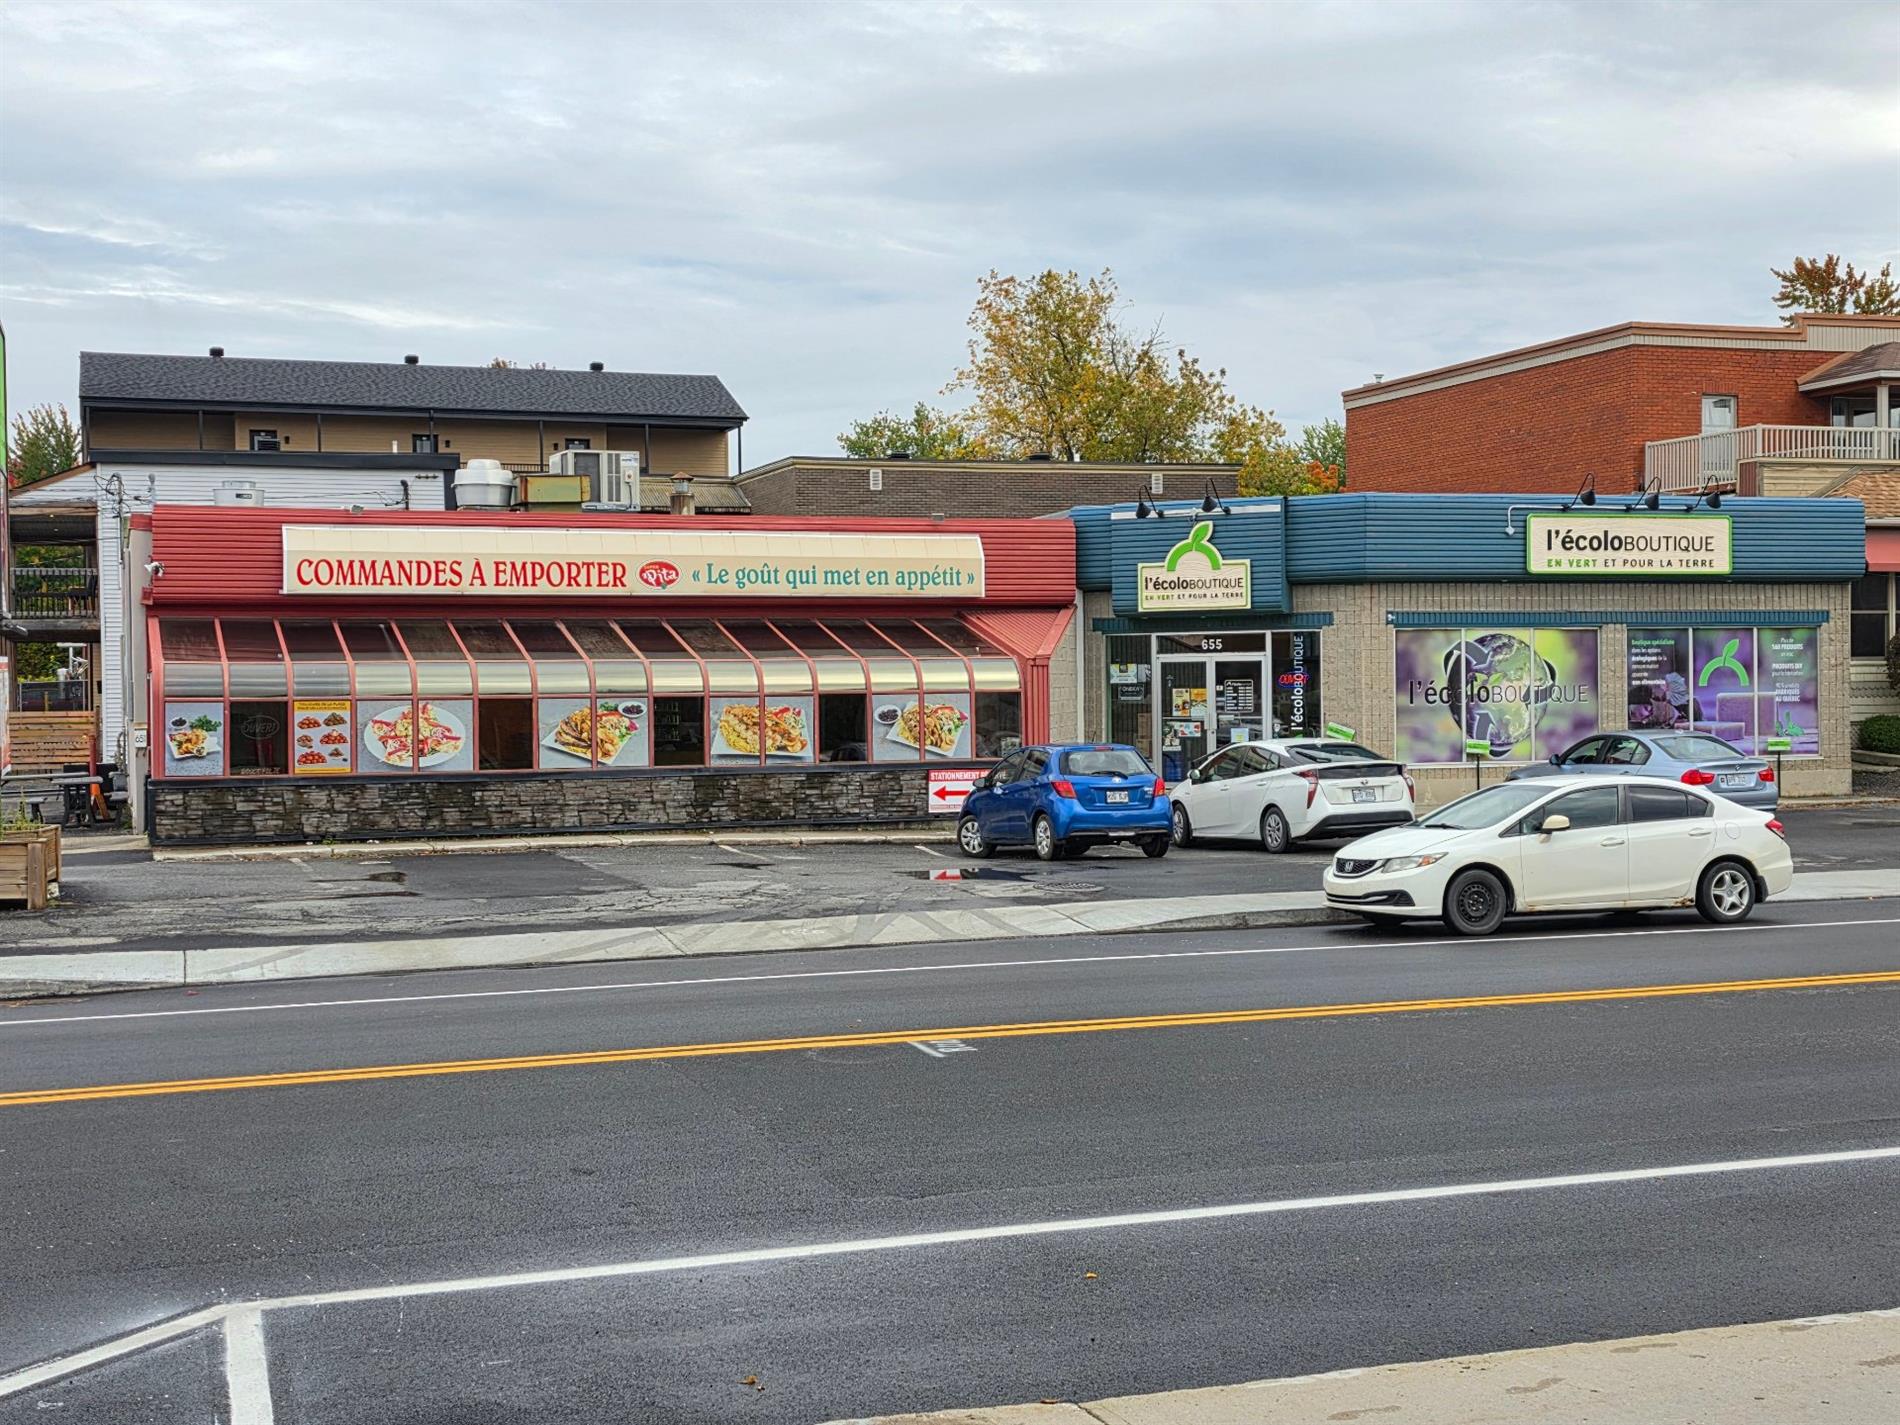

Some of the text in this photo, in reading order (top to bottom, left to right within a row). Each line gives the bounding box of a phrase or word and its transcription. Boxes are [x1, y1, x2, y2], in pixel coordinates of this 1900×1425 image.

[1547, 529, 1715, 552] l'écoloBOUTIQUE
[1547, 558, 1715, 568] EN VERT ET POUR LA TERRE
[296, 557, 627, 588] COMMANDES À EMPORTER
[706, 563, 729, 585] Le
[735, 562, 781, 589] goût
[785, 564, 817, 590] qui
[823, 566, 861, 586] met
[865, 569, 890, 586] en
[895, 564, 963, 591] appétit
[1144, 576, 1244, 591] l'écoloBOUTIQUE
[1157, 593, 1175, 601] VERT
[1201, 639, 1223, 650] 655
[1290, 634, 1304, 731] l'écoloBOUTIQUE
[930, 771, 980, 780] STATIONNEMENT
